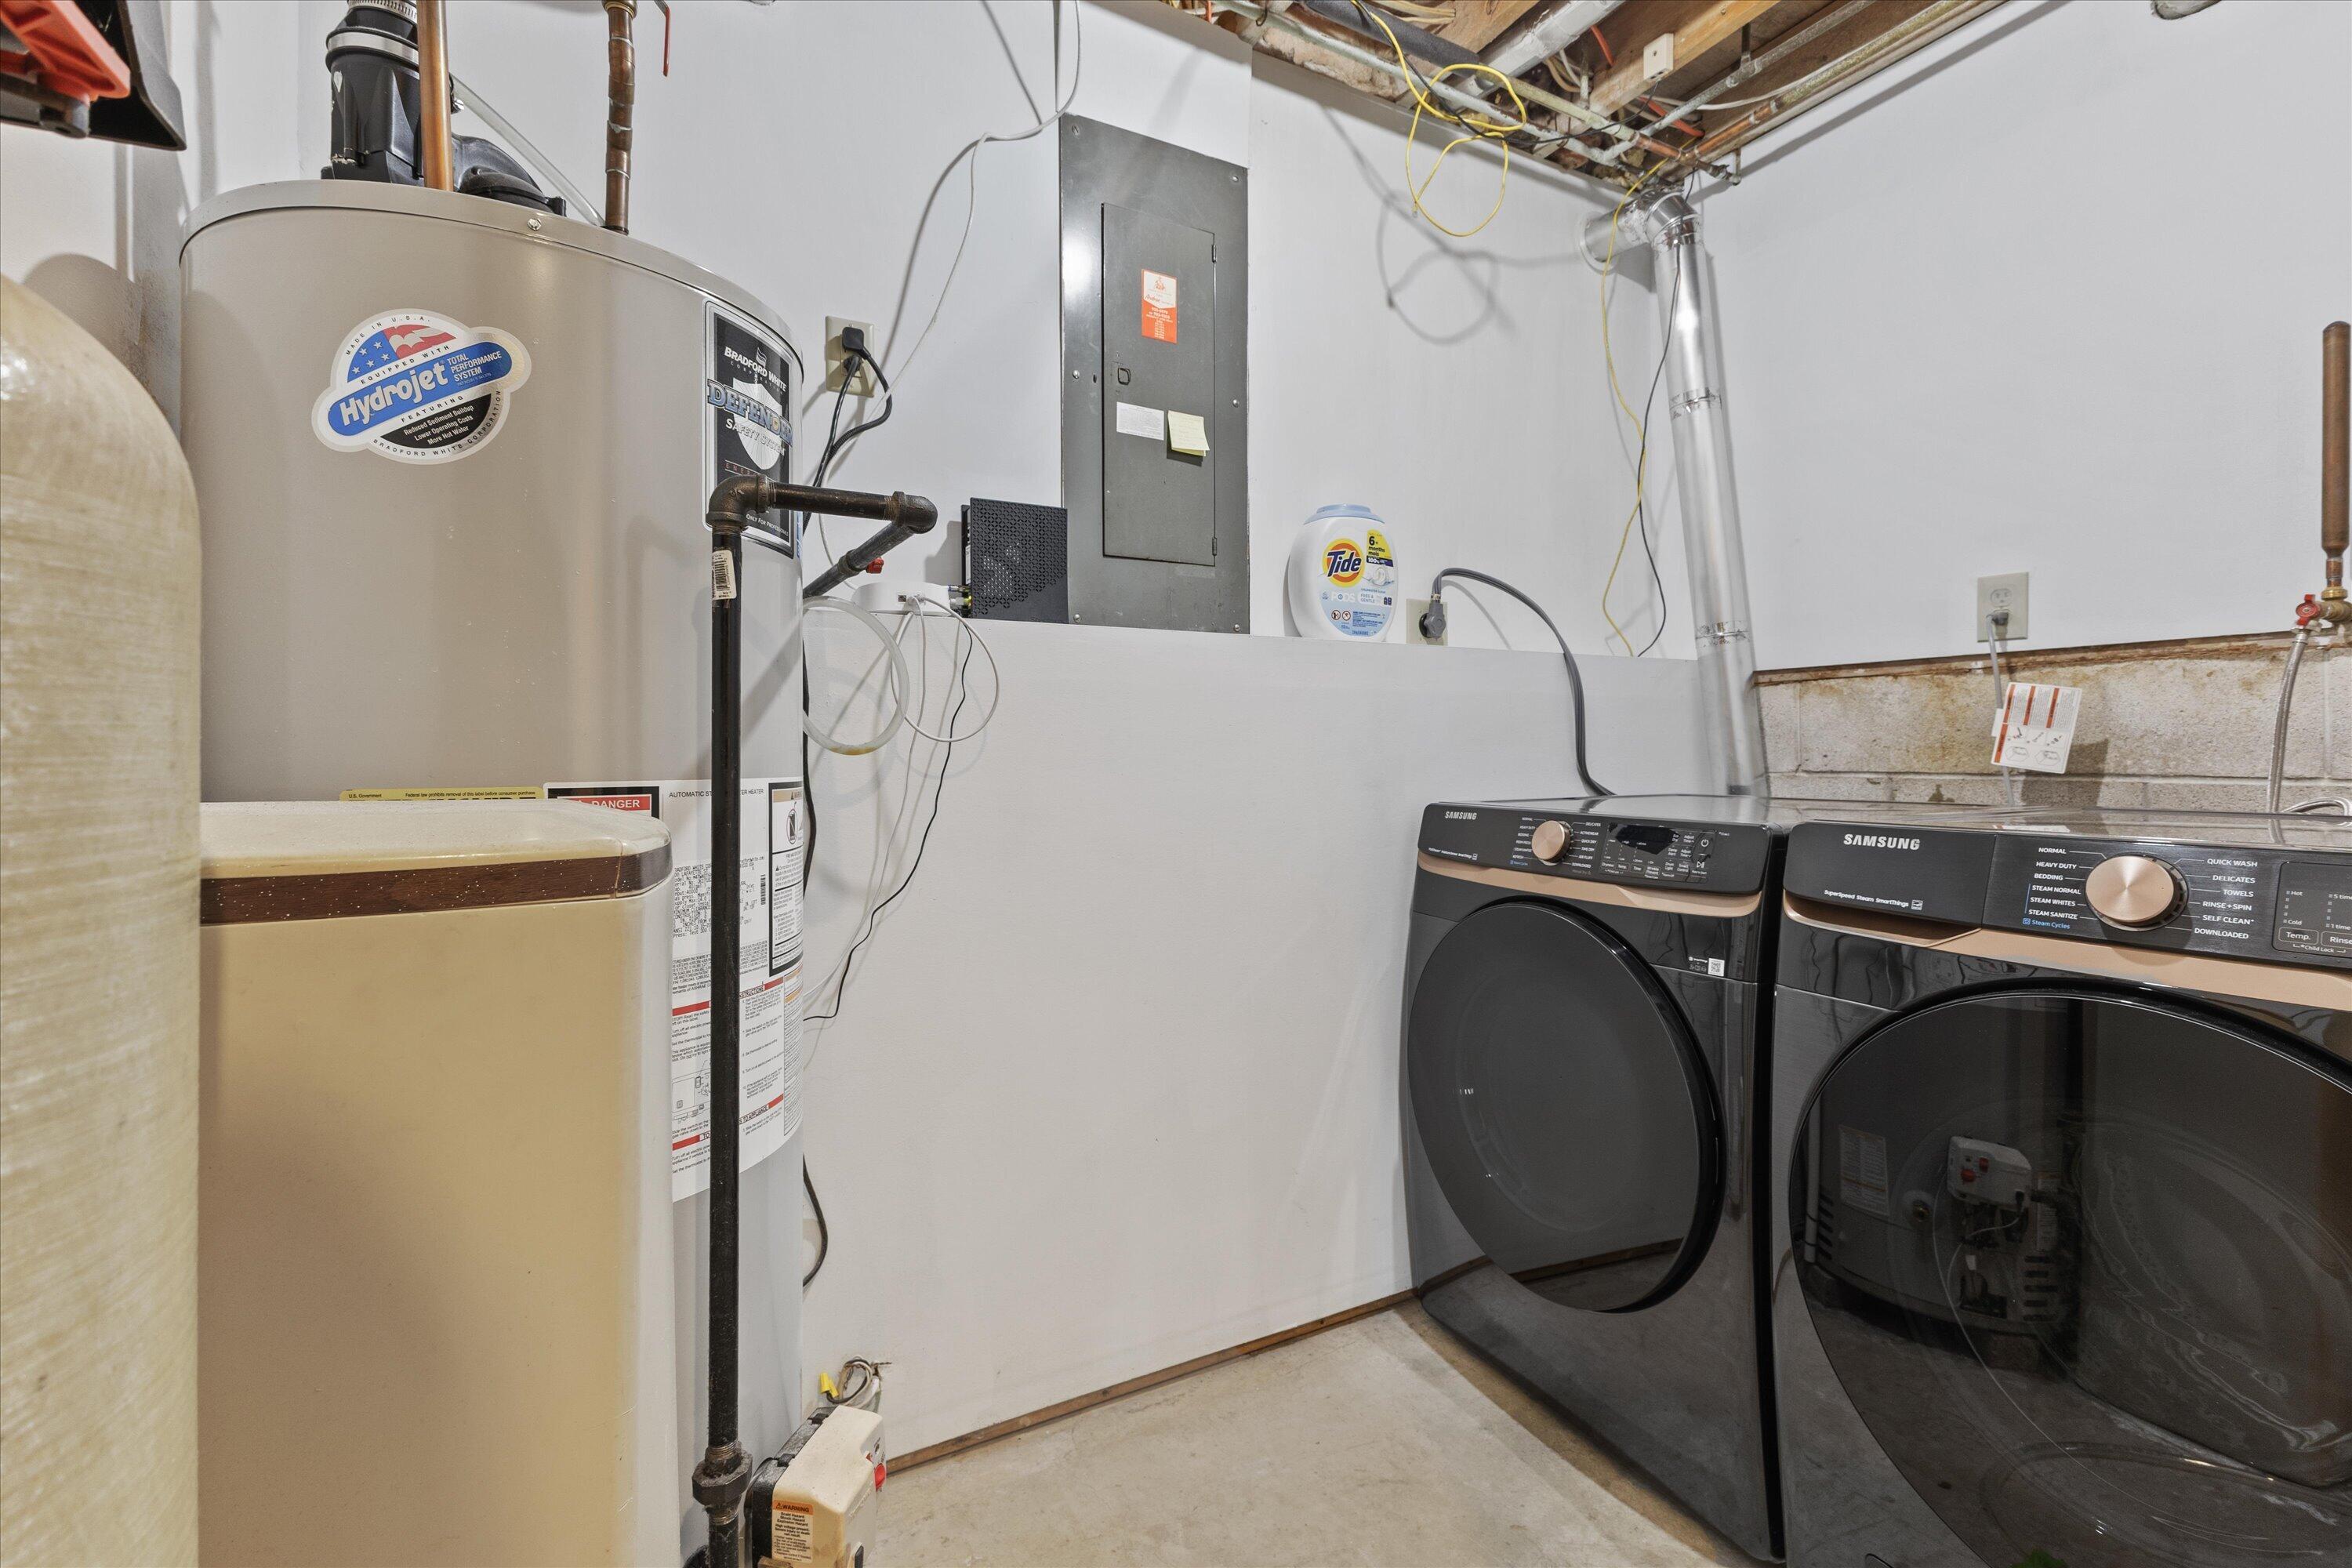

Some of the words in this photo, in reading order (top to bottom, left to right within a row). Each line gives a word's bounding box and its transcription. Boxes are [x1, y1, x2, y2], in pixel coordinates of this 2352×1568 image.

[346, 332, 365, 355] MADE
[361, 358, 415, 384] EQUIPPED
[422, 345, 449, 358] WITH
[447, 353, 469, 365] TOTAL
[450, 350, 502, 373] PERFORMANCE
[724, 346, 768, 377] BRADFORD
[768, 370, 787, 392] WHITE
[453, 366, 482, 382] SYSTEM
[339, 361, 448, 426] Hydrojet
[401, 395, 464, 423] FEATURING
[404, 421, 427, 436] Reduced
[427, 412, 453, 426] Sediment
[452, 405, 474, 417] Buildup
[707, 378, 793, 448] DEFENDER
[373, 439, 426, 456] BRADFORD
[432, 443, 463, 455] WHITE
[467, 391, 501, 444] CORPORATION
[415, 431, 431, 441] Lower
[431, 420, 459, 435] Operating
[458, 415, 474, 425] Costs
[726, 418, 760, 441] SAFETY
[427, 436, 441, 445] More
[452, 426, 469, 436] Water
[1327, 550, 1362, 577] Tide
[1445, 811, 1477, 820] SAMSUNG
[1843, 833, 1920, 851] SAMSUNG
[2212, 875, 2256, 884] DELICATES
[1824, 889, 1855, 899] SuperSpeed
[1875, 898, 1909, 908] SmartThings
[2223, 889, 2254, 898] TOWELS
[2194, 927, 2249, 939] DOWNLOADED
[2286, 931, 2311, 941] Temp.
[782, 1504, 810, 1513] WARNING
